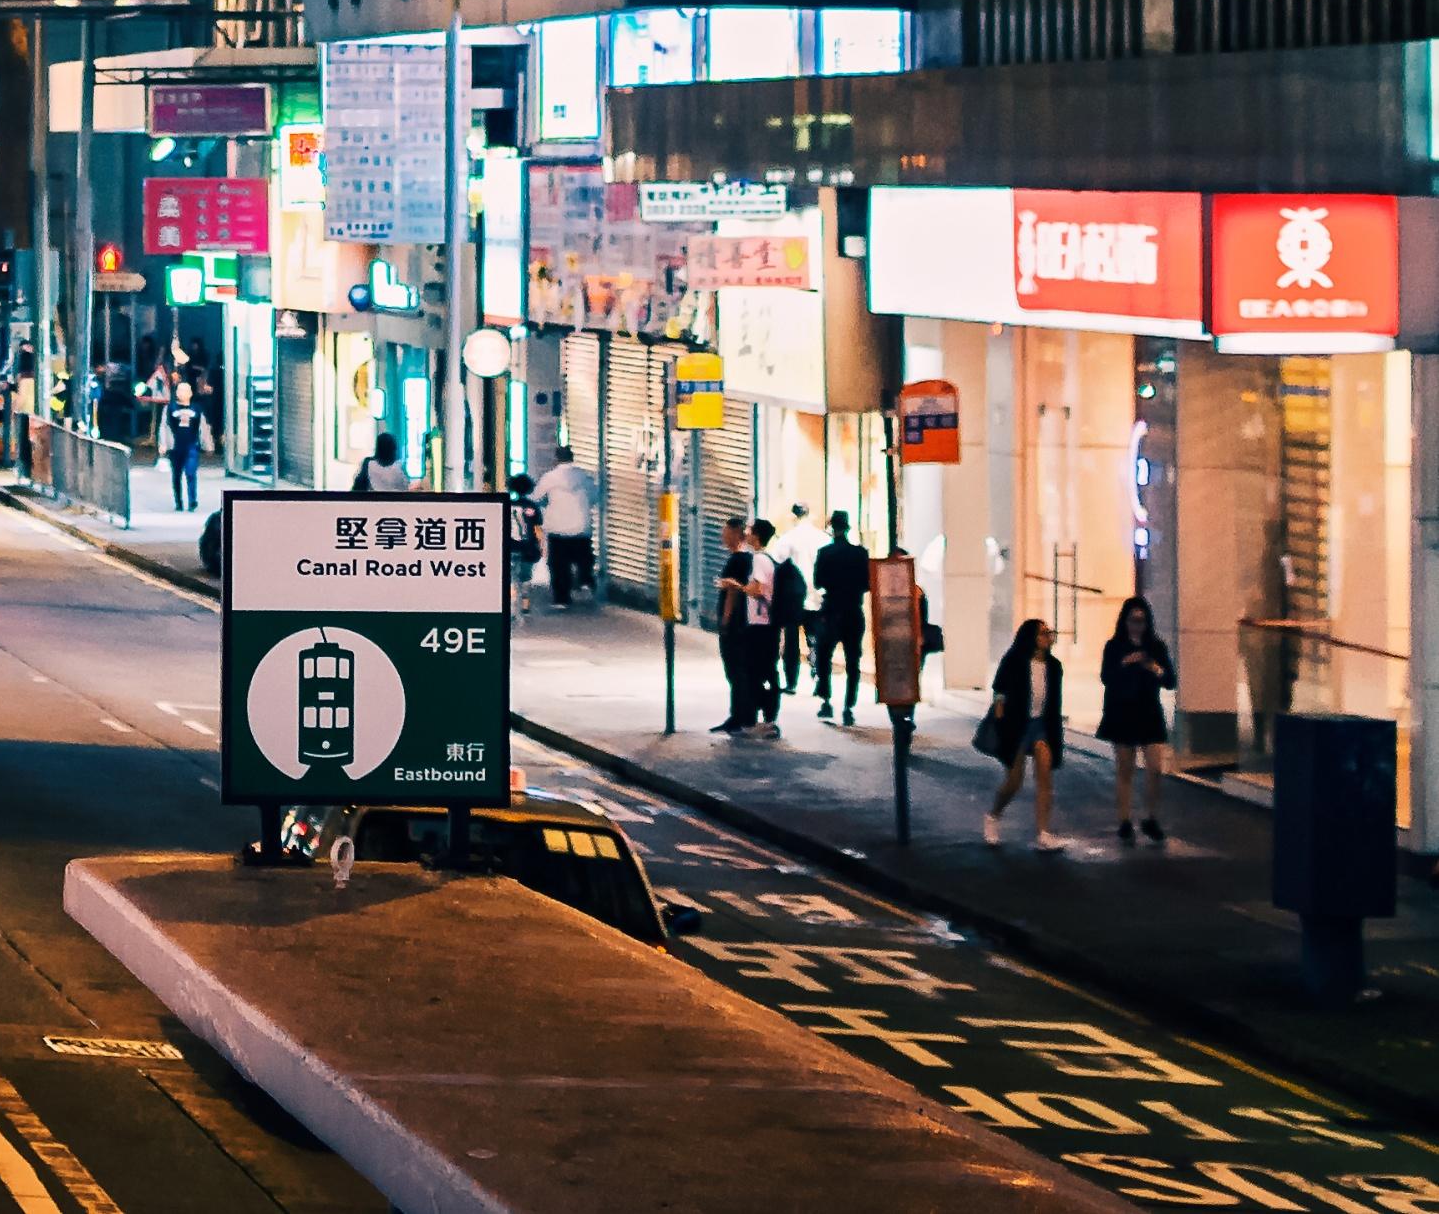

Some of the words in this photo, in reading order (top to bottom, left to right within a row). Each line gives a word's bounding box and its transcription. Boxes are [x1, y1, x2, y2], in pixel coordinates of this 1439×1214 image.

[335, 517, 486, 551] 堅拿道西
[297, 559, 357, 577] Canal
[366, 560, 422, 577] Road
[430, 561, 487, 578] West
[420, 627, 486, 654] 49E
[446, 743, 484, 763] 東行
[394, 767, 486, 783] Eastbound
